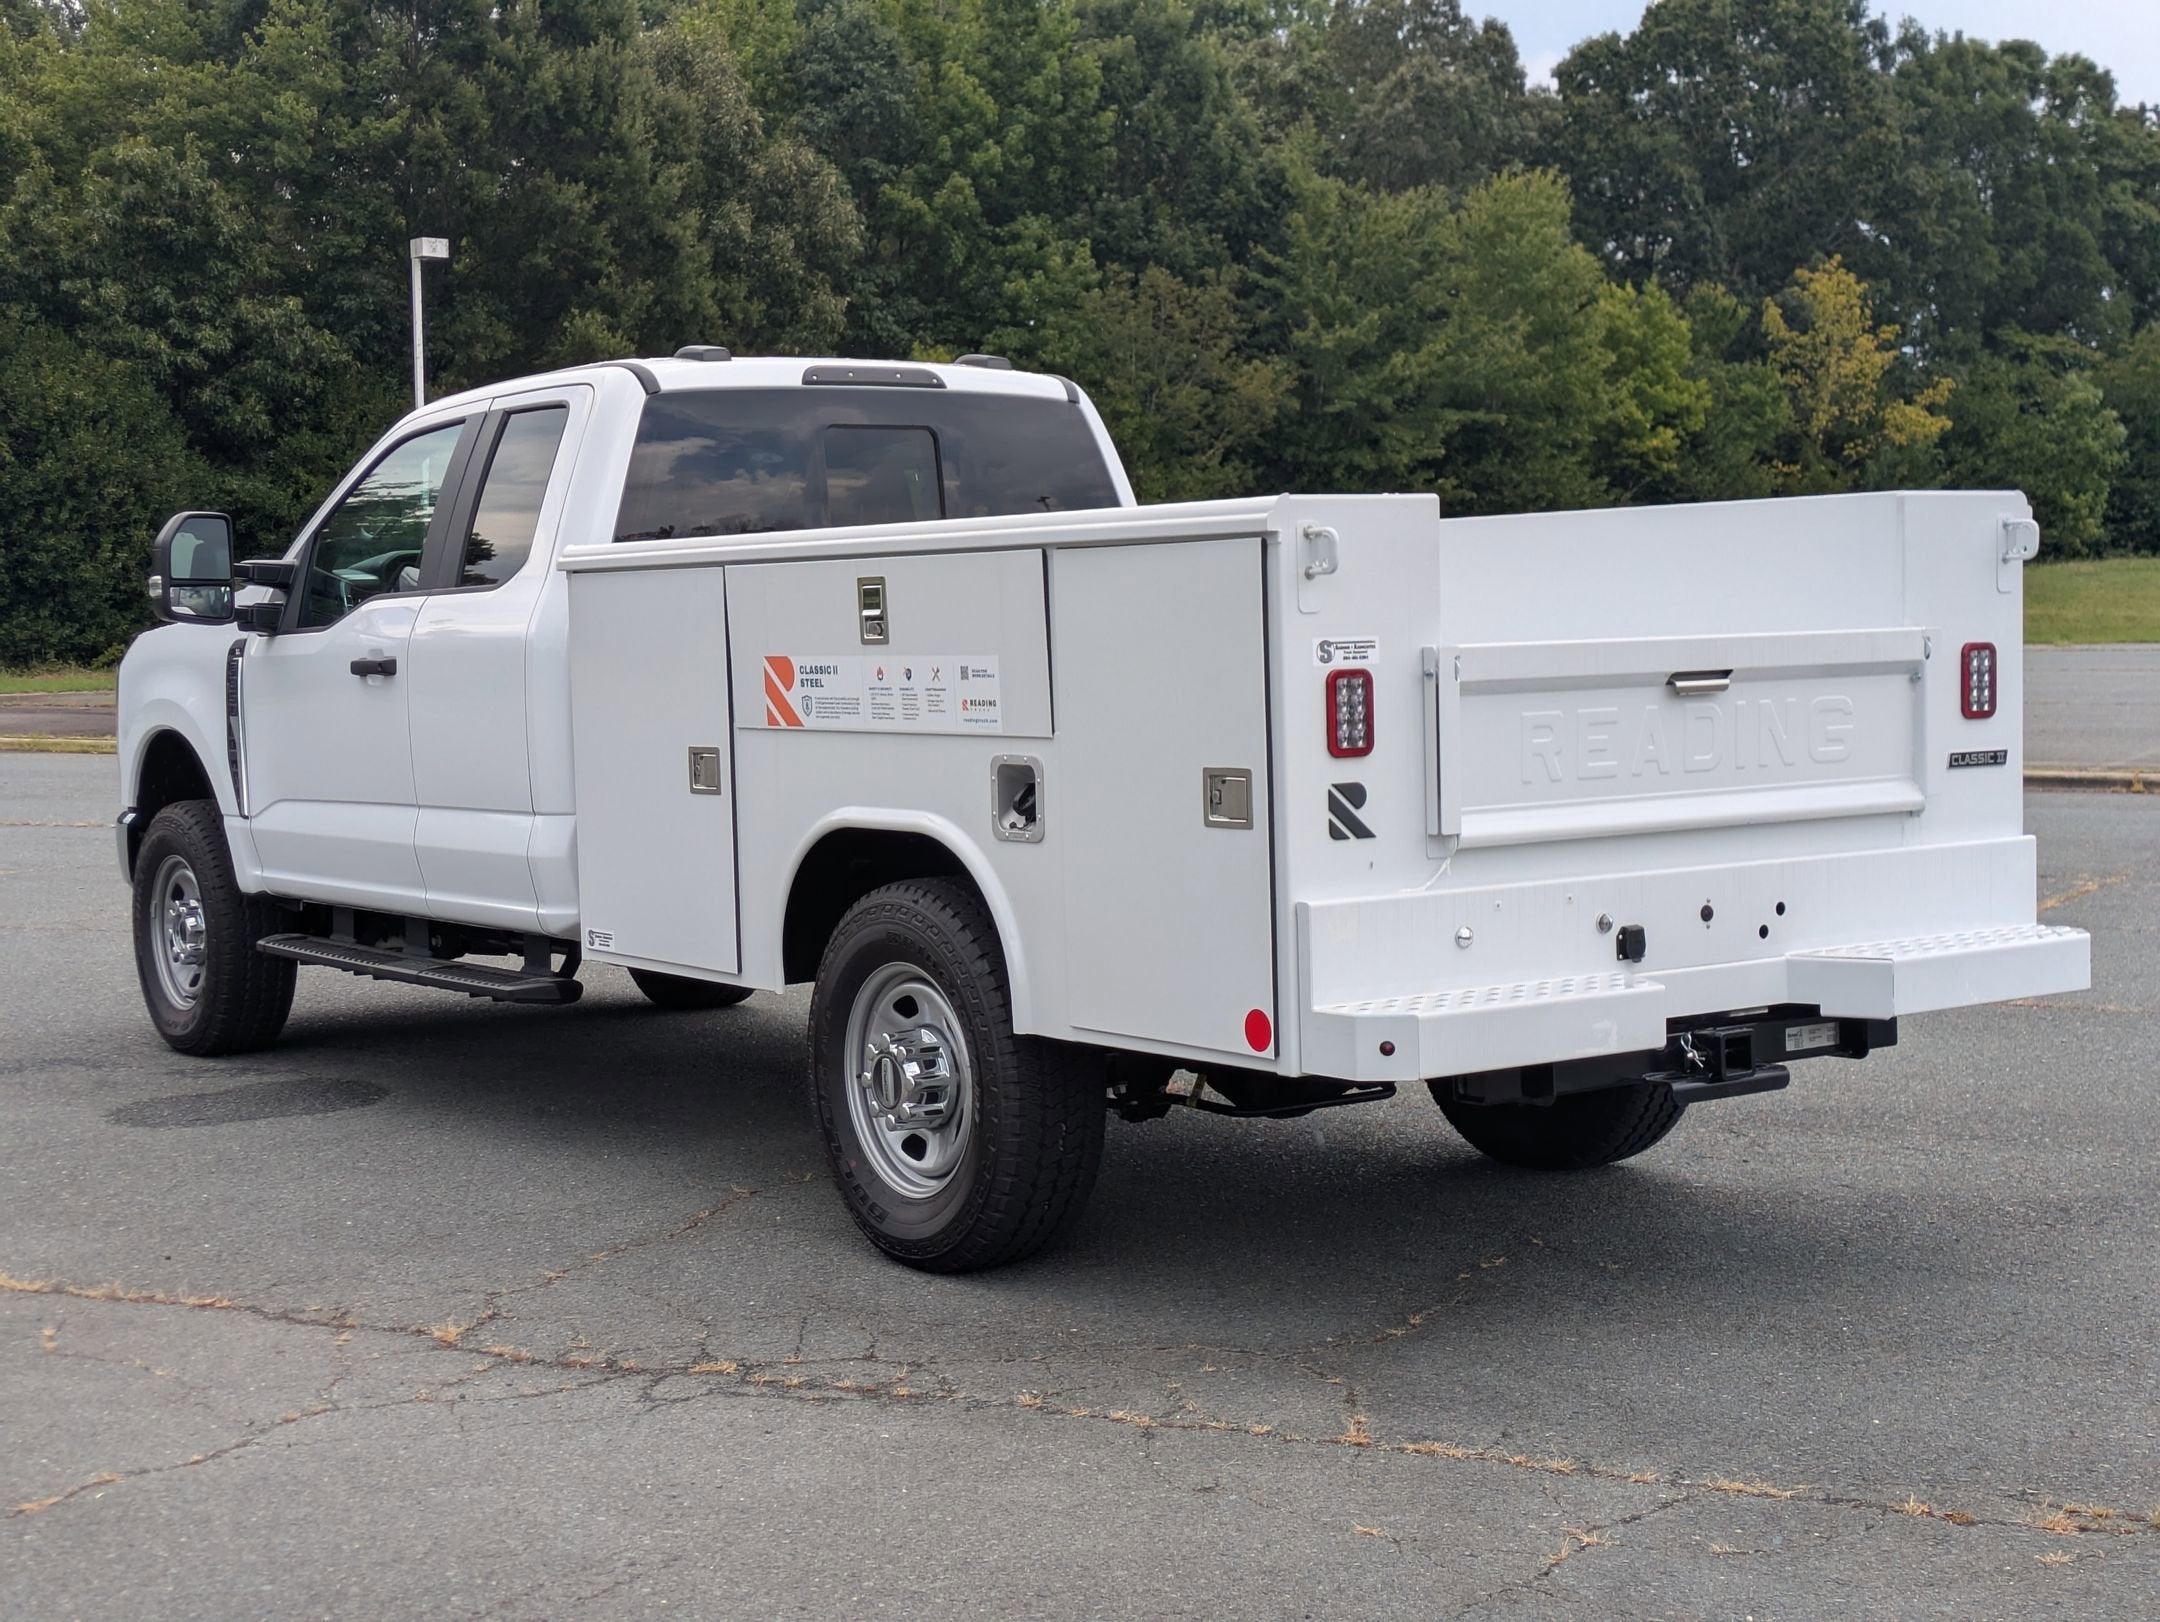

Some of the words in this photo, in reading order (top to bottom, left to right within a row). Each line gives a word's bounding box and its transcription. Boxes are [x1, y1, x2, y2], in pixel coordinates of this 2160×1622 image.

[799, 665, 832, 675] CLASSIC
[832, 665, 839, 675] II
[800, 678, 825, 688] STEEL
[969, 699, 997, 708] READING
[1520, 695, 1854, 785] READING
[1951, 752, 1995, 766] CLASSIC
[1996, 751, 2005, 763] II
